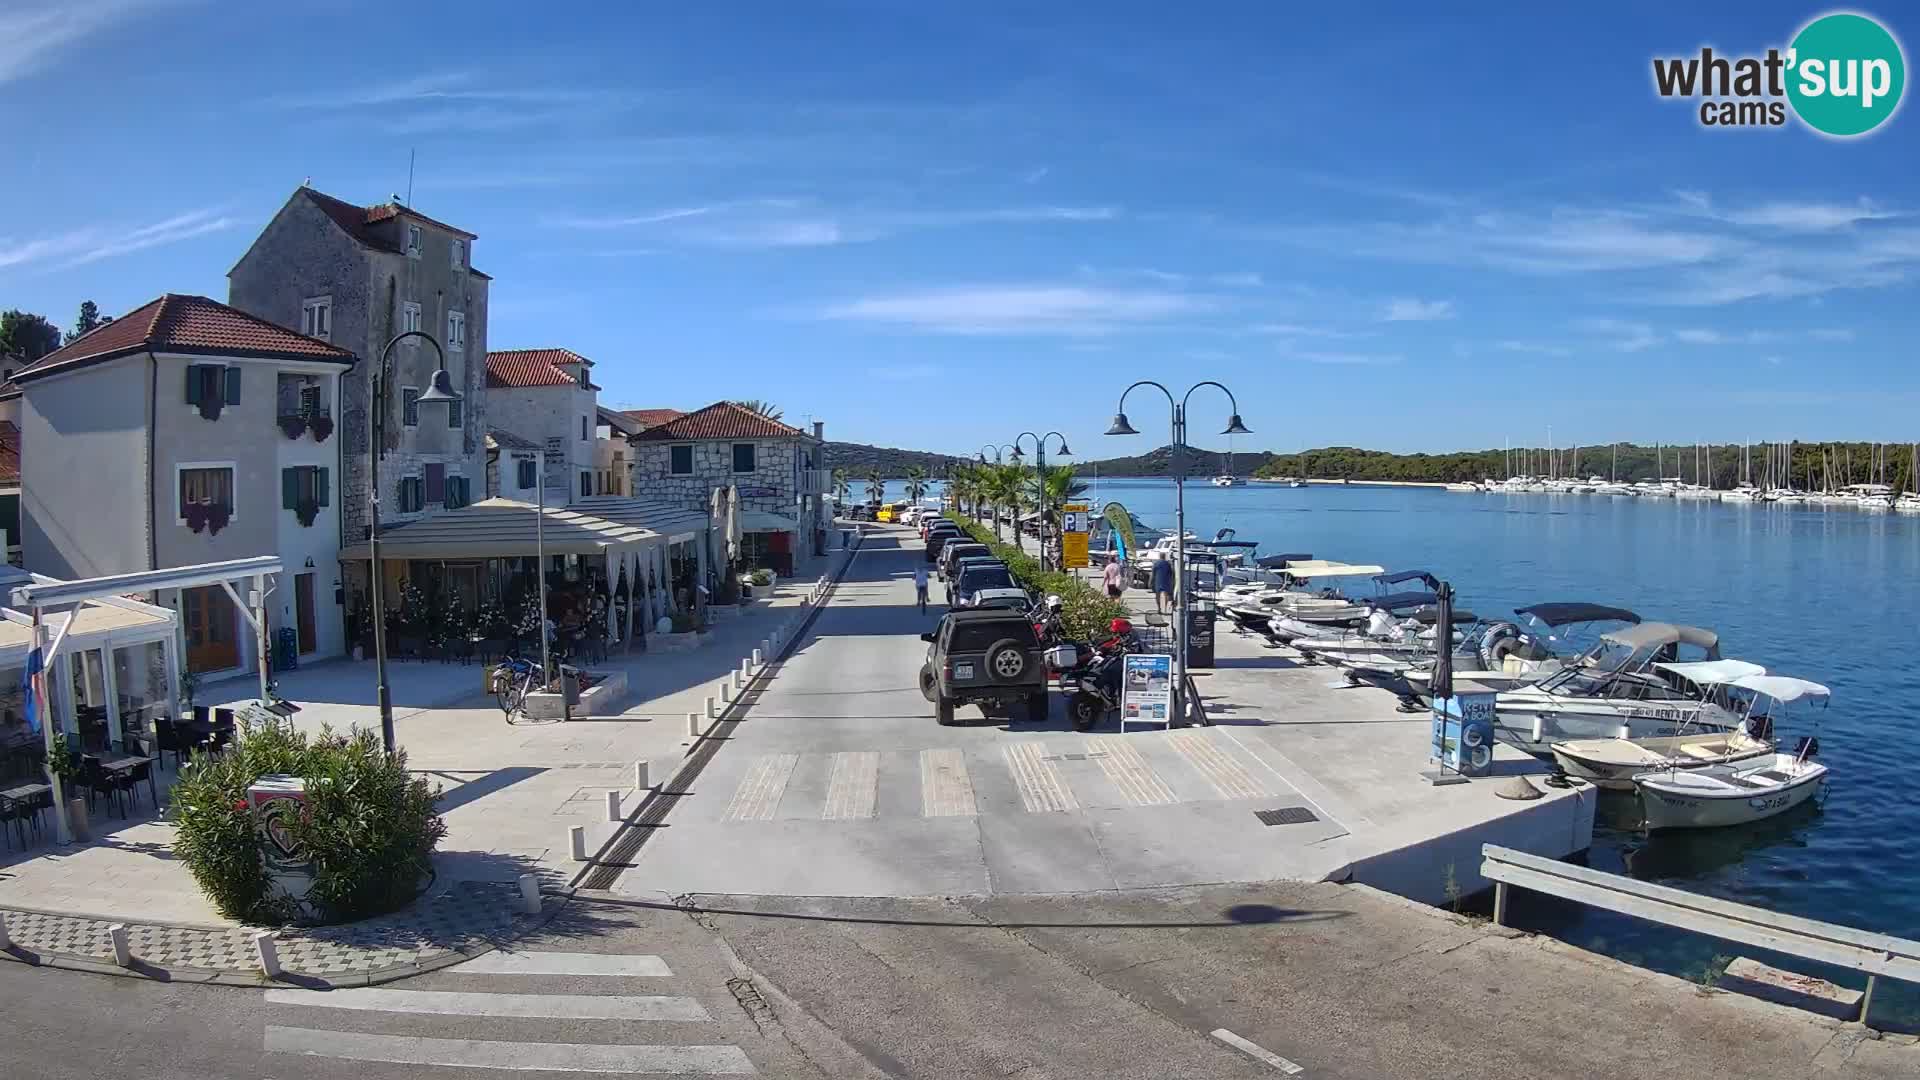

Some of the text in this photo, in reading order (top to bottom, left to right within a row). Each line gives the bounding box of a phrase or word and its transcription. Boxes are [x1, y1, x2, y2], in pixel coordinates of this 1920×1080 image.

[1064, 514, 1075, 530] P
[1463, 703, 1493, 712] RENT
[1463, 712, 1493, 720] A BOAT
[1655, 709, 1674, 720] RENT
